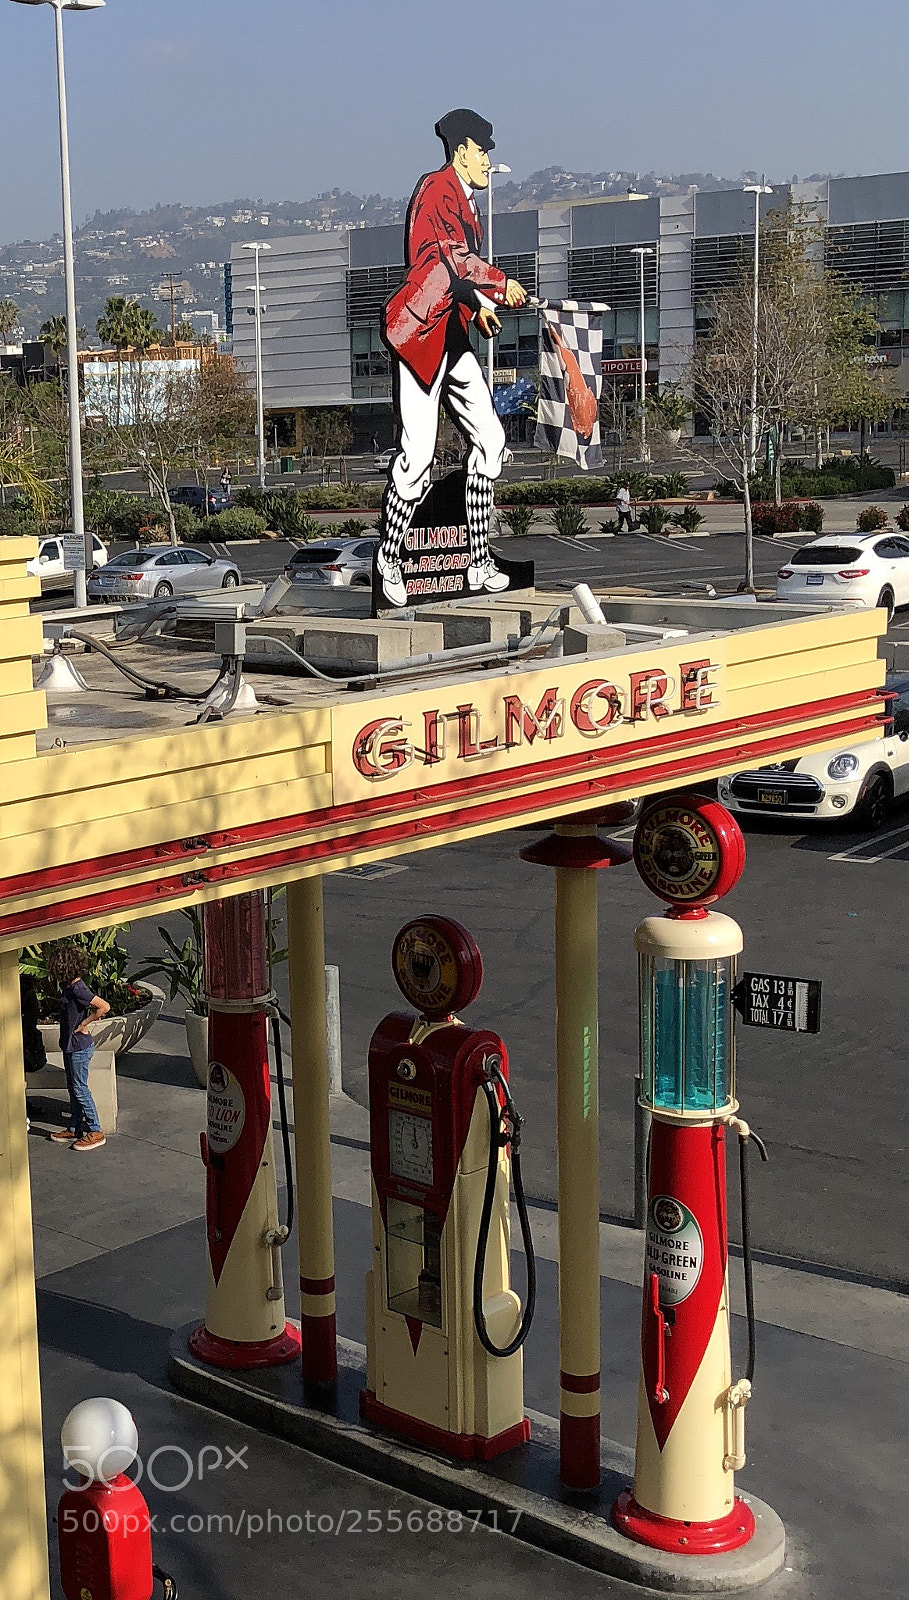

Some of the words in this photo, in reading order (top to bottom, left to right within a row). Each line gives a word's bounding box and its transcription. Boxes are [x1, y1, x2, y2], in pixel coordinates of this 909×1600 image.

[493, 369, 513, 377] OSTAL
[601, 362, 641, 372] HIPOTLE
[404, 525, 468, 551] GILMORE
[418, 553, 471, 572] RECORD
[406, 574, 464, 596] BREAKER
[352, 658, 722, 781] GILMORE
[641, 810, 713, 848] GILMORE
[642, 860, 714, 895] GASOLINE
[751, 977, 770, 993] GAS
[773, 980, 785, 995] 13
[751, 993, 769, 1009] TAX
[778, 996, 785, 1010] 4
[750, 1008, 770, 1024] TOTAL
[773, 1011, 784, 1026] 17
[389, 1086, 432, 1107] GILMORE
[216, 1108, 241, 1124] LION
